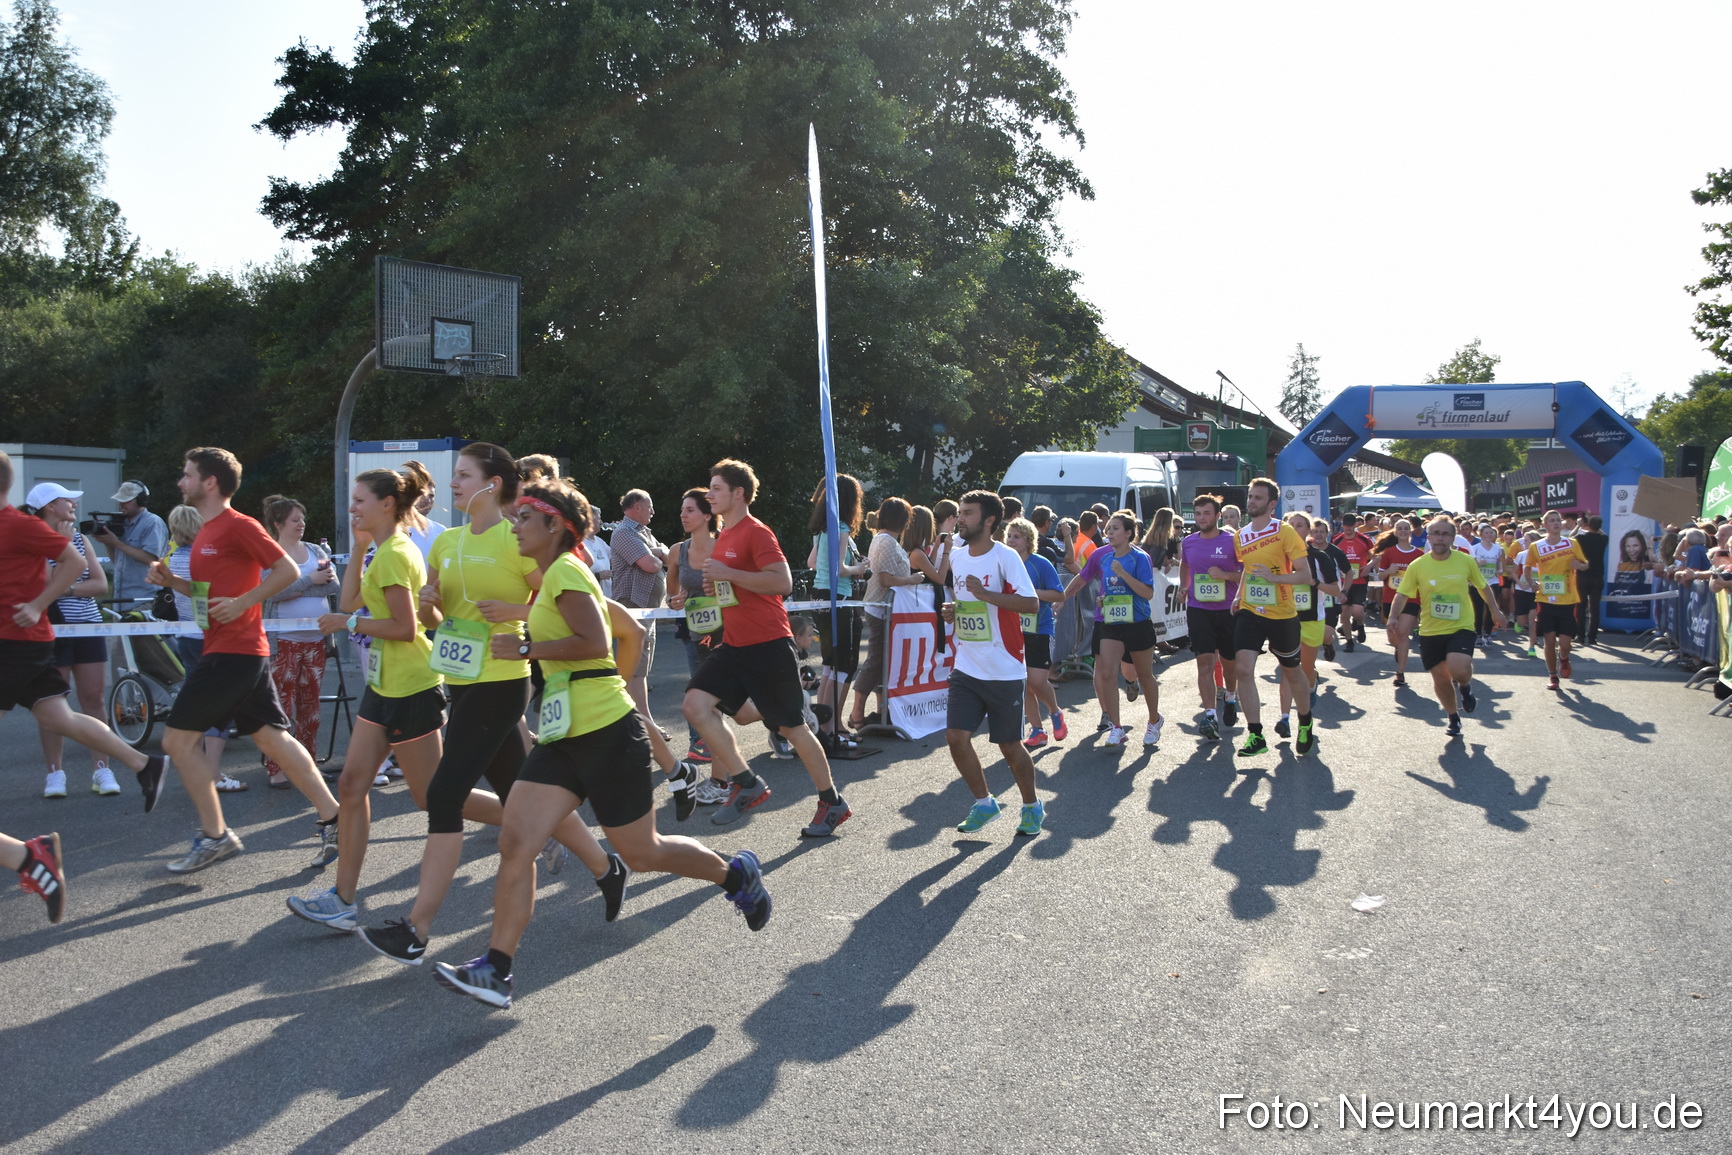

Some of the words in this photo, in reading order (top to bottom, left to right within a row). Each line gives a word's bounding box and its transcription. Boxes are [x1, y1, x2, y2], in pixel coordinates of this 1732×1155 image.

[1442, 410, 1511, 423] firmenlauf
[1316, 434, 1351, 442] Fischer
[1546, 482, 1567, 498] RW
[1706, 481, 1730, 508] AOK
[1517, 494, 1534, 507] RW
[1215, 546, 1223, 555] K
[1241, 544, 1258, 556] MAX
[1260, 536, 1281, 549] BÖGL
[1540, 554, 1556, 563] MAX
[1557, 549, 1574, 558] BÖGL
[1200, 585, 1219, 595] 693
[1250, 586, 1270, 598] 864
[1544, 582, 1561, 590] 876
[1109, 606, 1127, 617] 488
[1435, 604, 1454, 614] 671
[689, 608, 717, 625] 1291
[956, 616, 986, 631] 1503
[439, 639, 473, 664] 682
